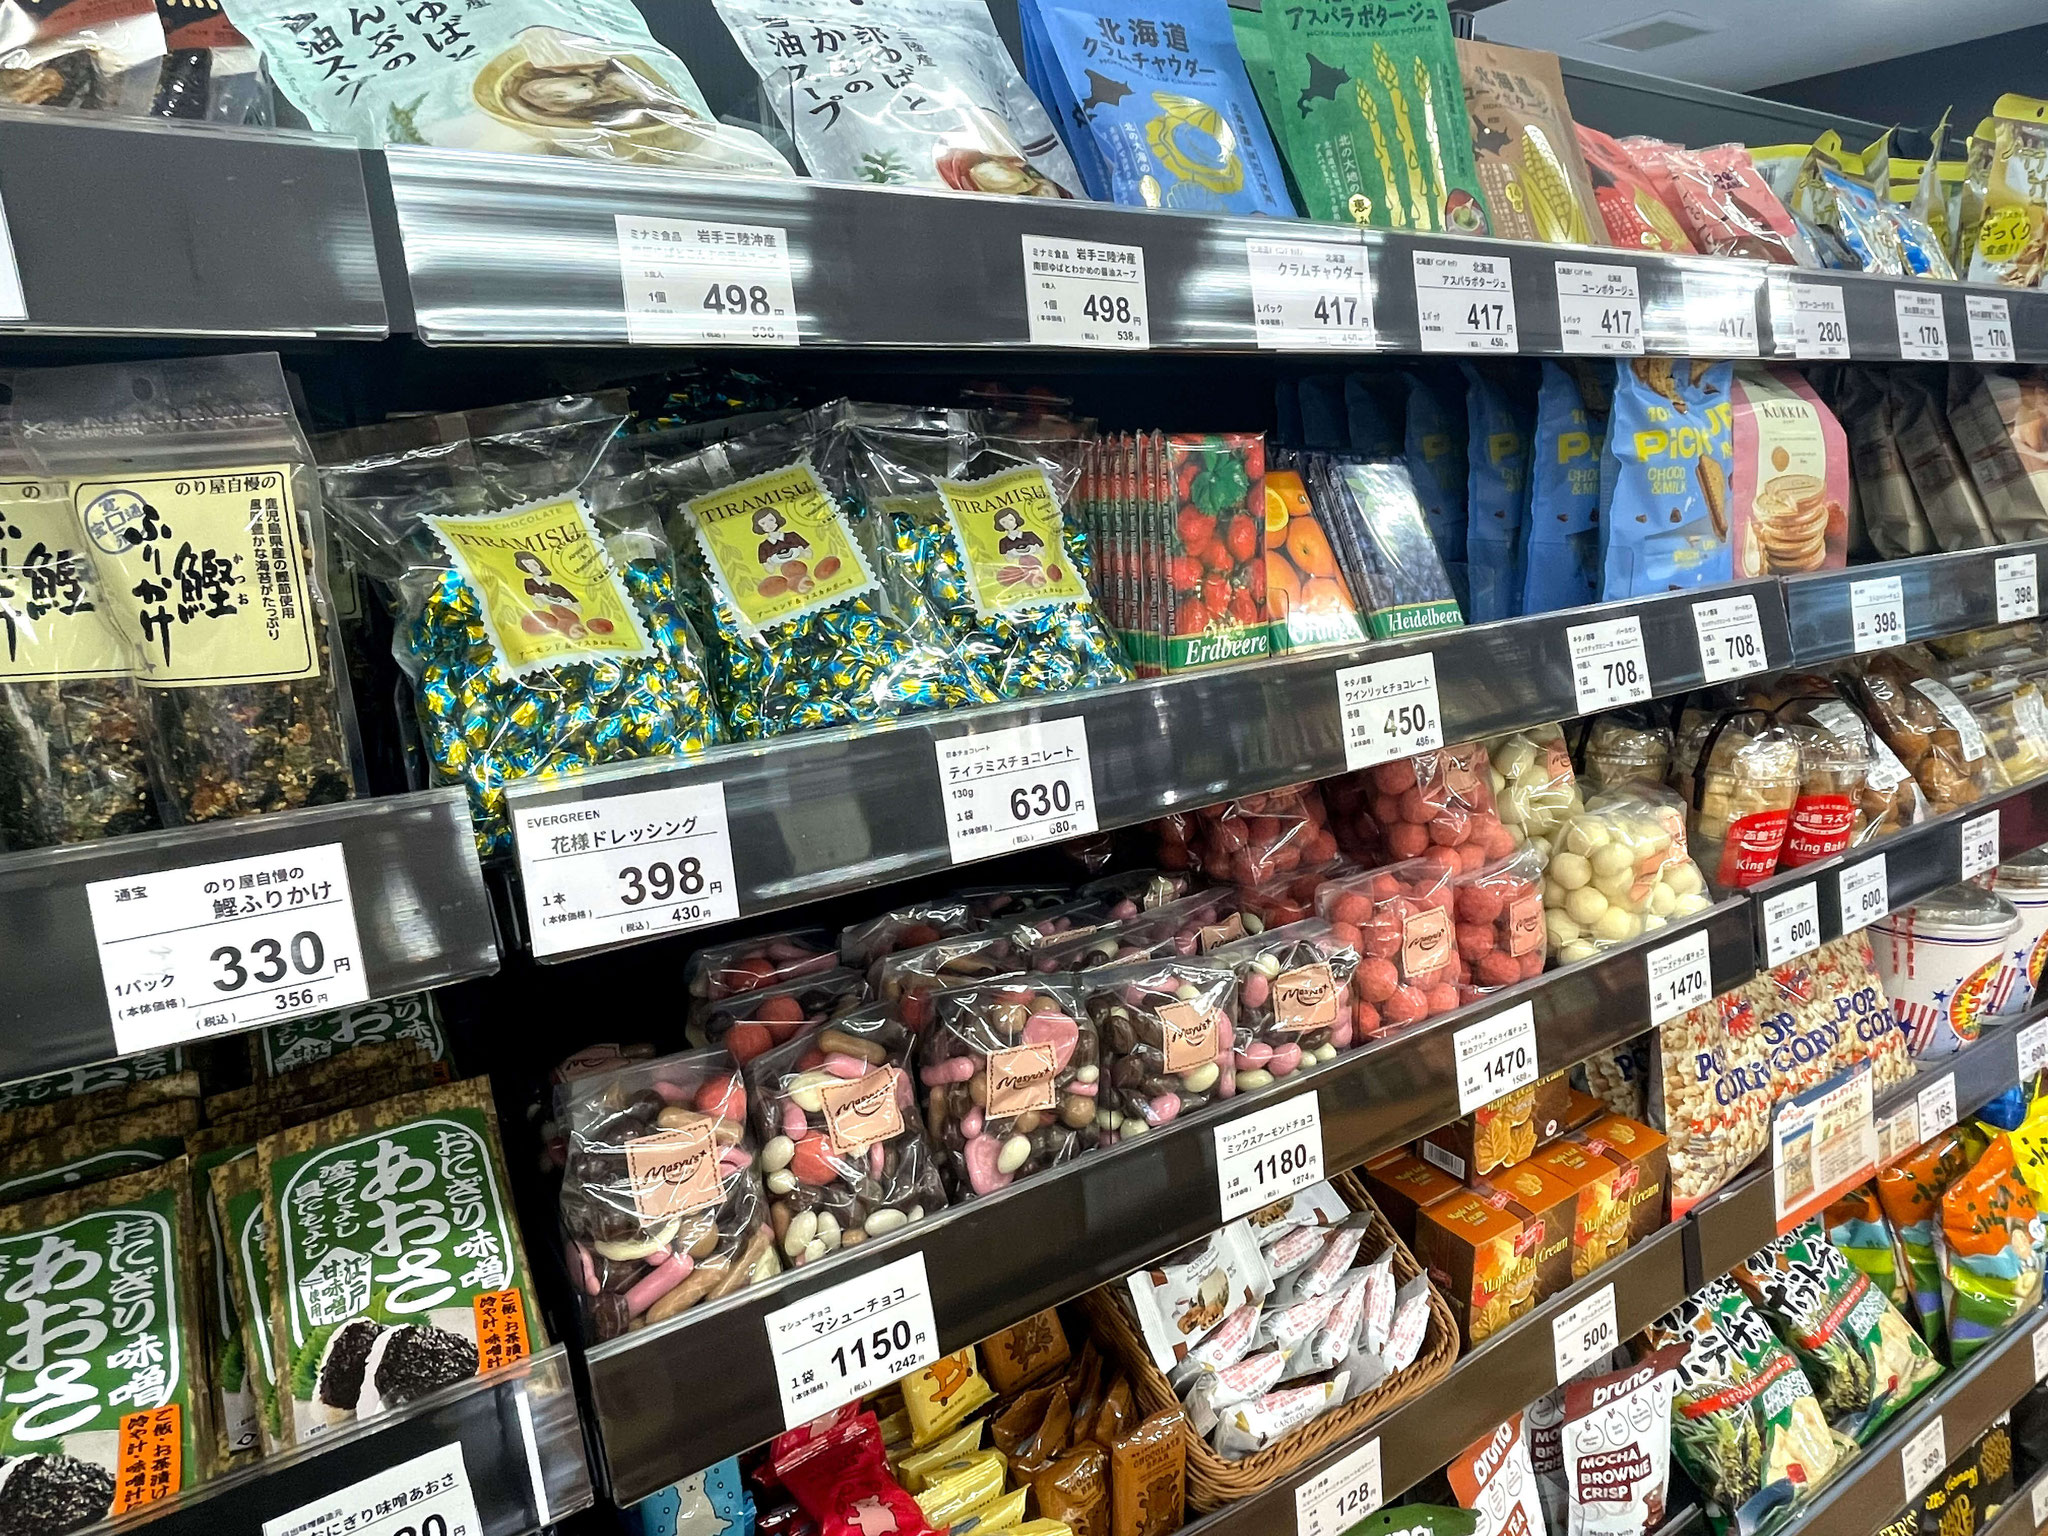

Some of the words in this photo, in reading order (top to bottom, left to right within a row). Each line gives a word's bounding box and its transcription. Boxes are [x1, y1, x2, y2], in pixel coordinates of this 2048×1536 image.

[1285, 2, 1439, 31] アスパラポタージュ
[1097, 17, 1190, 53] 北海道
[1082, 37, 1216, 78] クラムチャウダー
[1338, 134, 1361, 194] 北の大地の
[631, 228, 682, 243] ミナミ食品
[697, 229, 777, 247] 岩手三陸沖産
[1076, 247, 1137, 265] 岩手三陸沖産
[1278, 263, 1364, 280] クラムチャウダー
[1442, 275, 1507, 289] アスパラポタージュ
[1582, 284, 1634, 297] コーンポタージュ
[1761, 403, 1809, 419] KUKKIA
[175, 476, 277, 496] のり屋自慢の
[951, 485, 1048, 515] TIRAMISU
[699, 480, 818, 524] TIRAMISU
[494, 508, 563, 530] CHOCOLATE
[451, 521, 582, 552] TIRAMISU
[124, 504, 176, 668] ふりかけ
[1388, 605, 1463, 632] Heidelbeere
[1184, 633, 1268, 666] Erdbeere
[949, 745, 1074, 780] ティラミスチョコレート
[952, 788, 974, 799] 130g
[527, 810, 600, 829] EVERGREEN
[551, 815, 698, 855] 花様ドレッシング
[1790, 838, 1821, 855] King
[1736, 857, 1764, 873] King
[114, 885, 149, 903] 通宝
[203, 866, 304, 895] のり屋自慢の
[212, 880, 333, 920] 鰹ふりかけ
[114, 973, 176, 998] 1パック
[118, 997, 186, 1020] (本体価格)
[1833, 987, 1877, 1022] POP
[1772, 1020, 1840, 1073] CORN
[1715, 1058, 1771, 1106] CORN
[1228, 1114, 1313, 1154] ミックスアーモンドチョコ
[644, 1149, 708, 1186] Masyu's
[433, 1130, 505, 1290] おにぎり味噌
[1632, 1183, 1660, 1207] Cream
[360, 1138, 457, 1314] あおさ
[1538, 1236, 1569, 1263] Cream
[309, 1288, 322, 1318] 使用
[320, 1262, 347, 1316] 甘味噌
[107, 1219, 168, 1408] おにぎり味噌
[779, 1306, 832, 1333] マシューチョコ
[812, 1287, 905, 1334] マシューチョコ
[5, 1236, 109, 1441] あおさ
[1592, 1367, 1654, 1409] bruno
[1473, 1421, 1514, 1487] bruno
[1581, 1448, 1638, 1470] MOCHA
[1581, 1461, 1650, 1485] BROWNIE
[1582, 1485, 1629, 1500] CRISP
